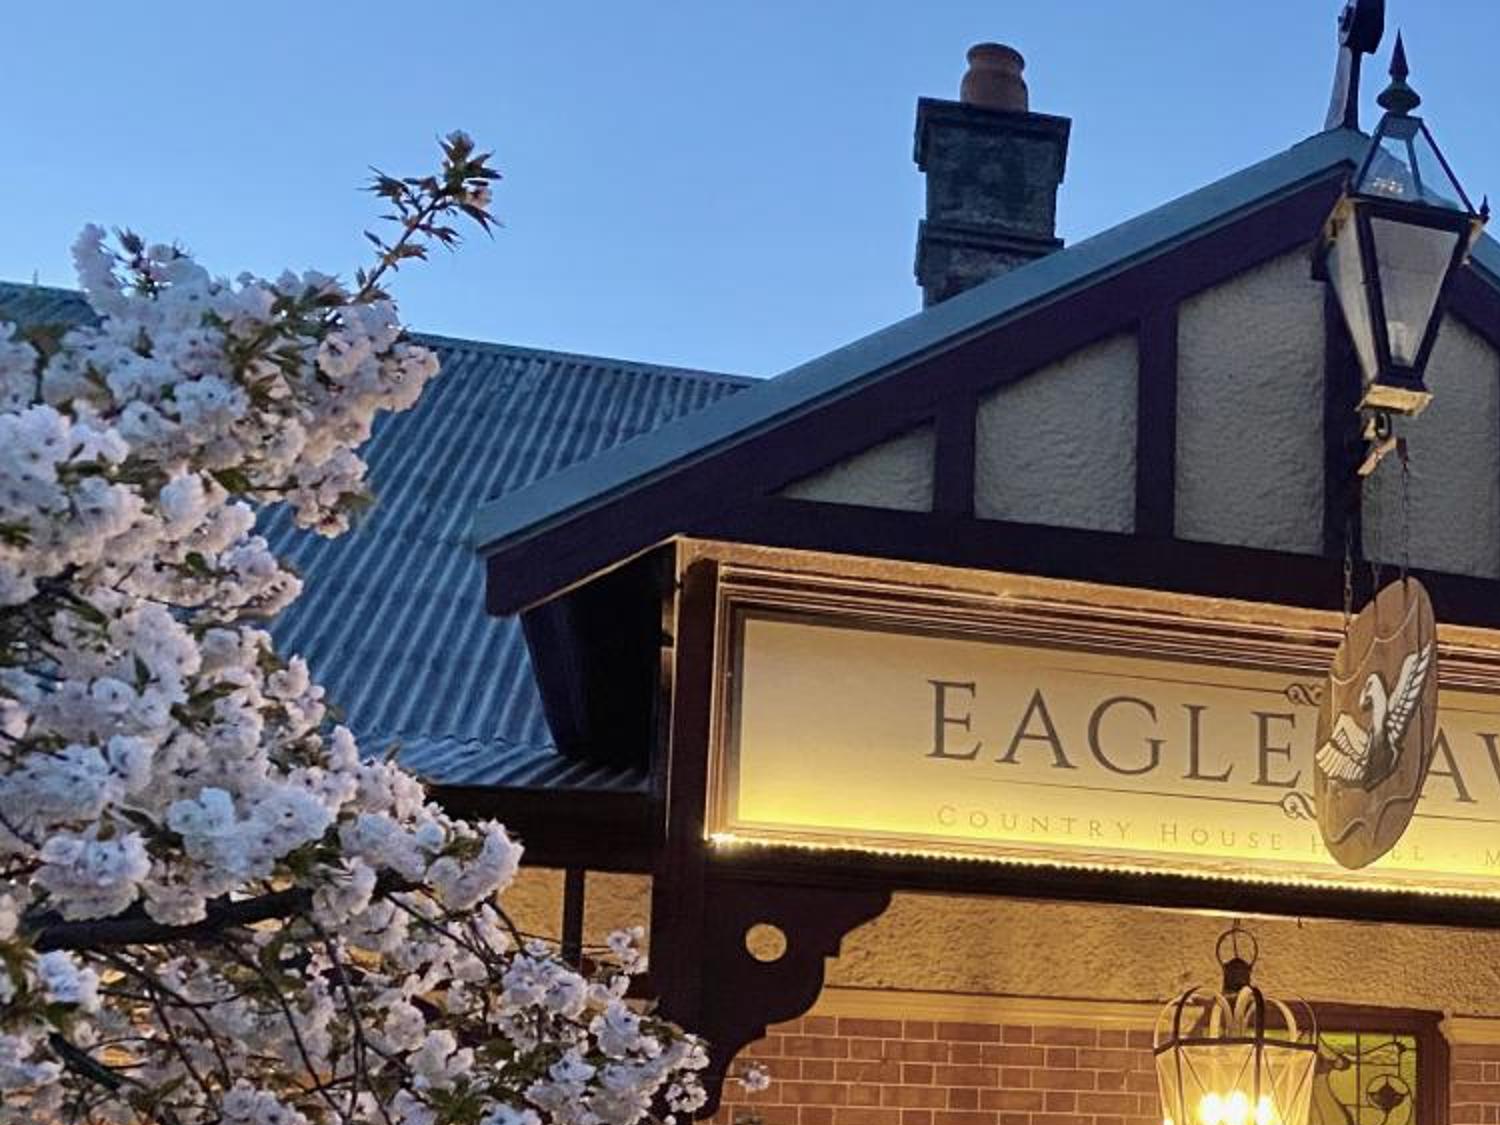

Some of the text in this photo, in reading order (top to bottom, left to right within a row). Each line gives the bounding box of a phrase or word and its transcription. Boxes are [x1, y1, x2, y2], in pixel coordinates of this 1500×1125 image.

[936, 804, 1134, 841] COUNTRY
[1161, 822, 1283, 852] HOUSE
[1311, 832, 1425, 862] HEL
